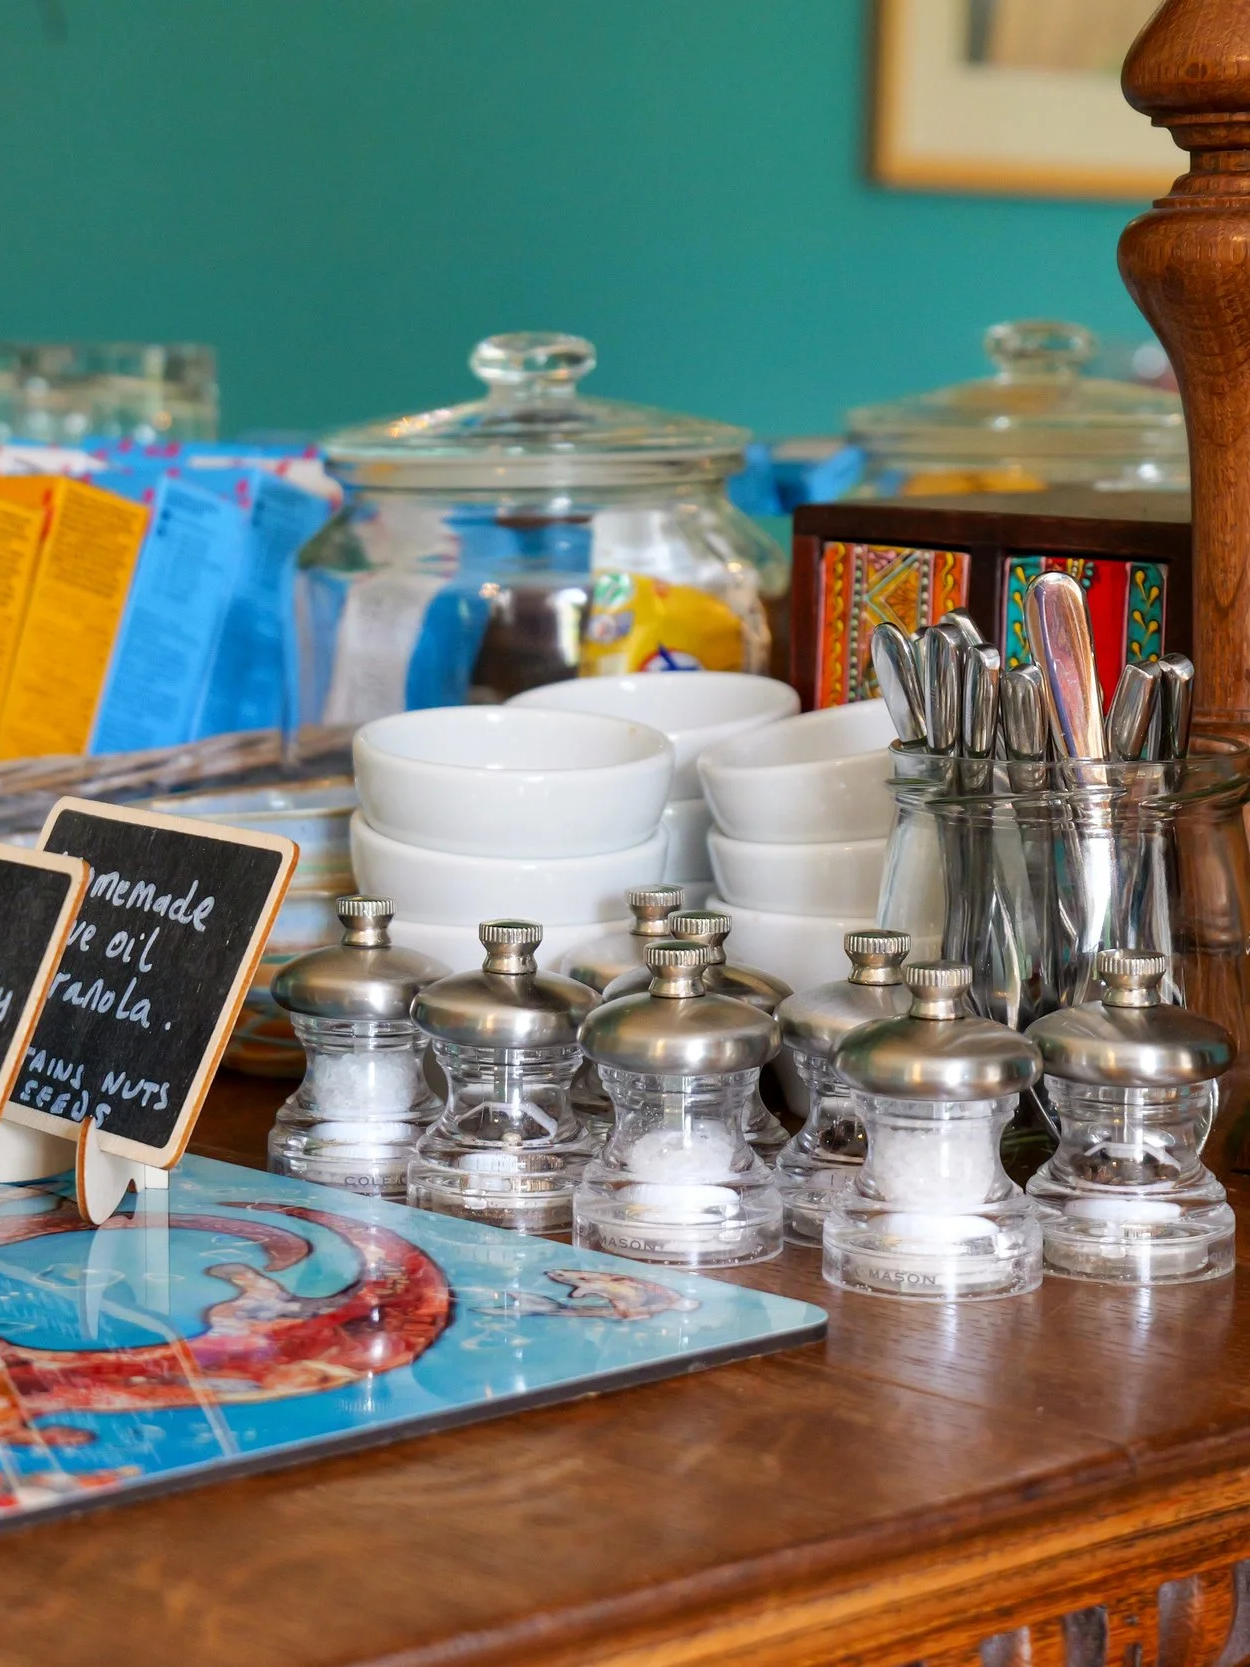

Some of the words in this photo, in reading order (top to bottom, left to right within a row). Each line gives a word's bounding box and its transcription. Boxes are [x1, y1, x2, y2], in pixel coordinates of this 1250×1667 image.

[63, 851, 215, 932] memade
[101, 1071, 170, 1110] NUTS
[344, 1176, 390, 1187] COLE
[598, 1234, 656, 1251] MASON
[869, 1269, 936, 1285] MASON
